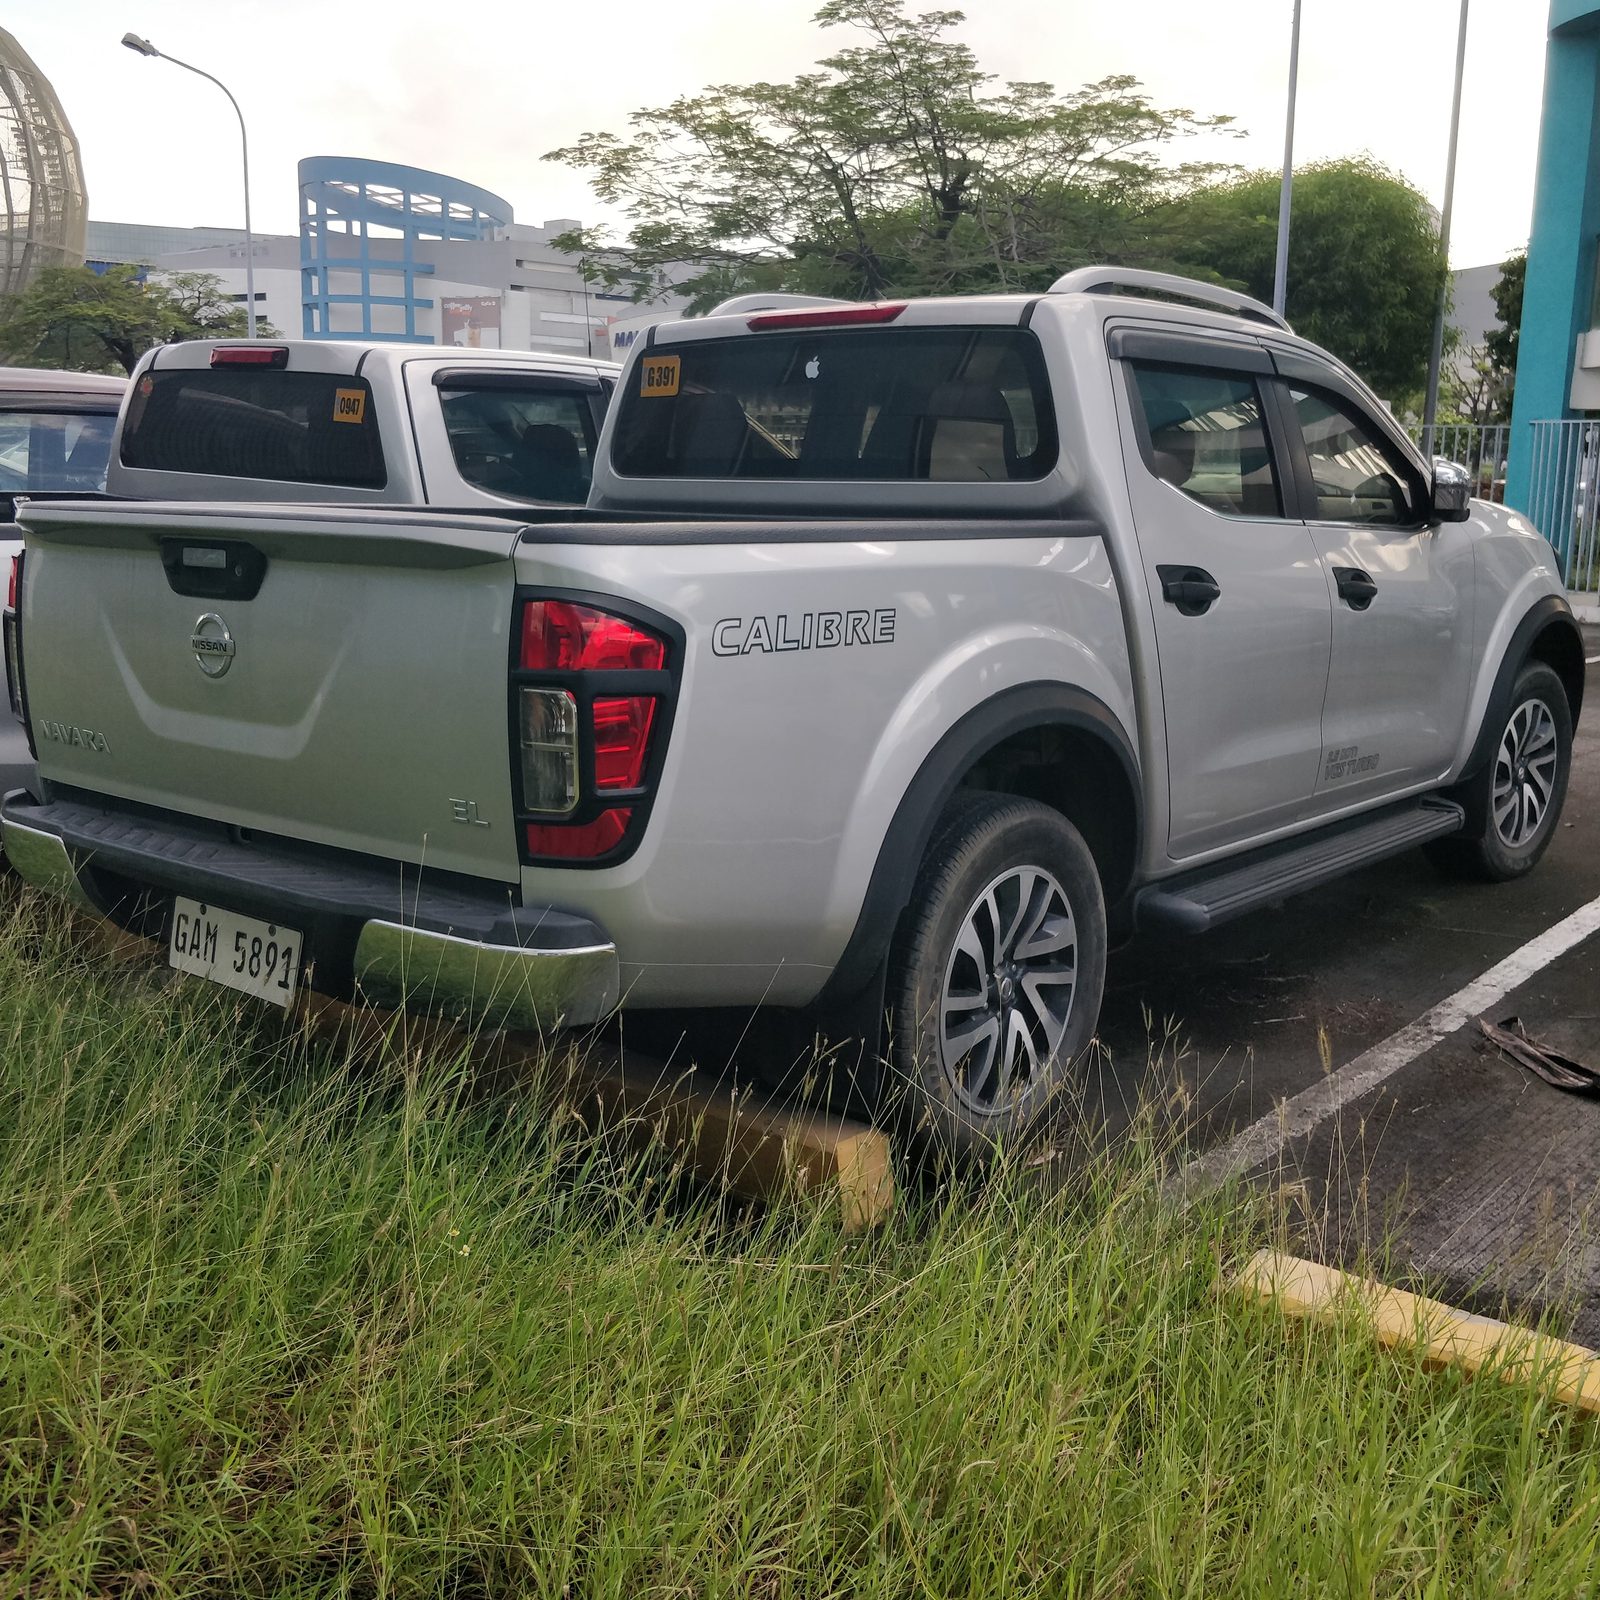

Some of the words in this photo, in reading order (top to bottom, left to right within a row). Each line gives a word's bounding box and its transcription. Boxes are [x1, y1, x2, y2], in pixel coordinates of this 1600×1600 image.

[614, 330, 639, 347] MA
[648, 366, 676, 387] G391
[340, 397, 361, 416] 0947
[192, 639, 228, 652] NISSAN
[711, 608, 897, 658] CALIBRE
[40, 719, 112, 754] NAVARA
[448, 797, 491, 828] EL
[174, 913, 218, 964] GAM
[233, 930, 293, 990] 5891
